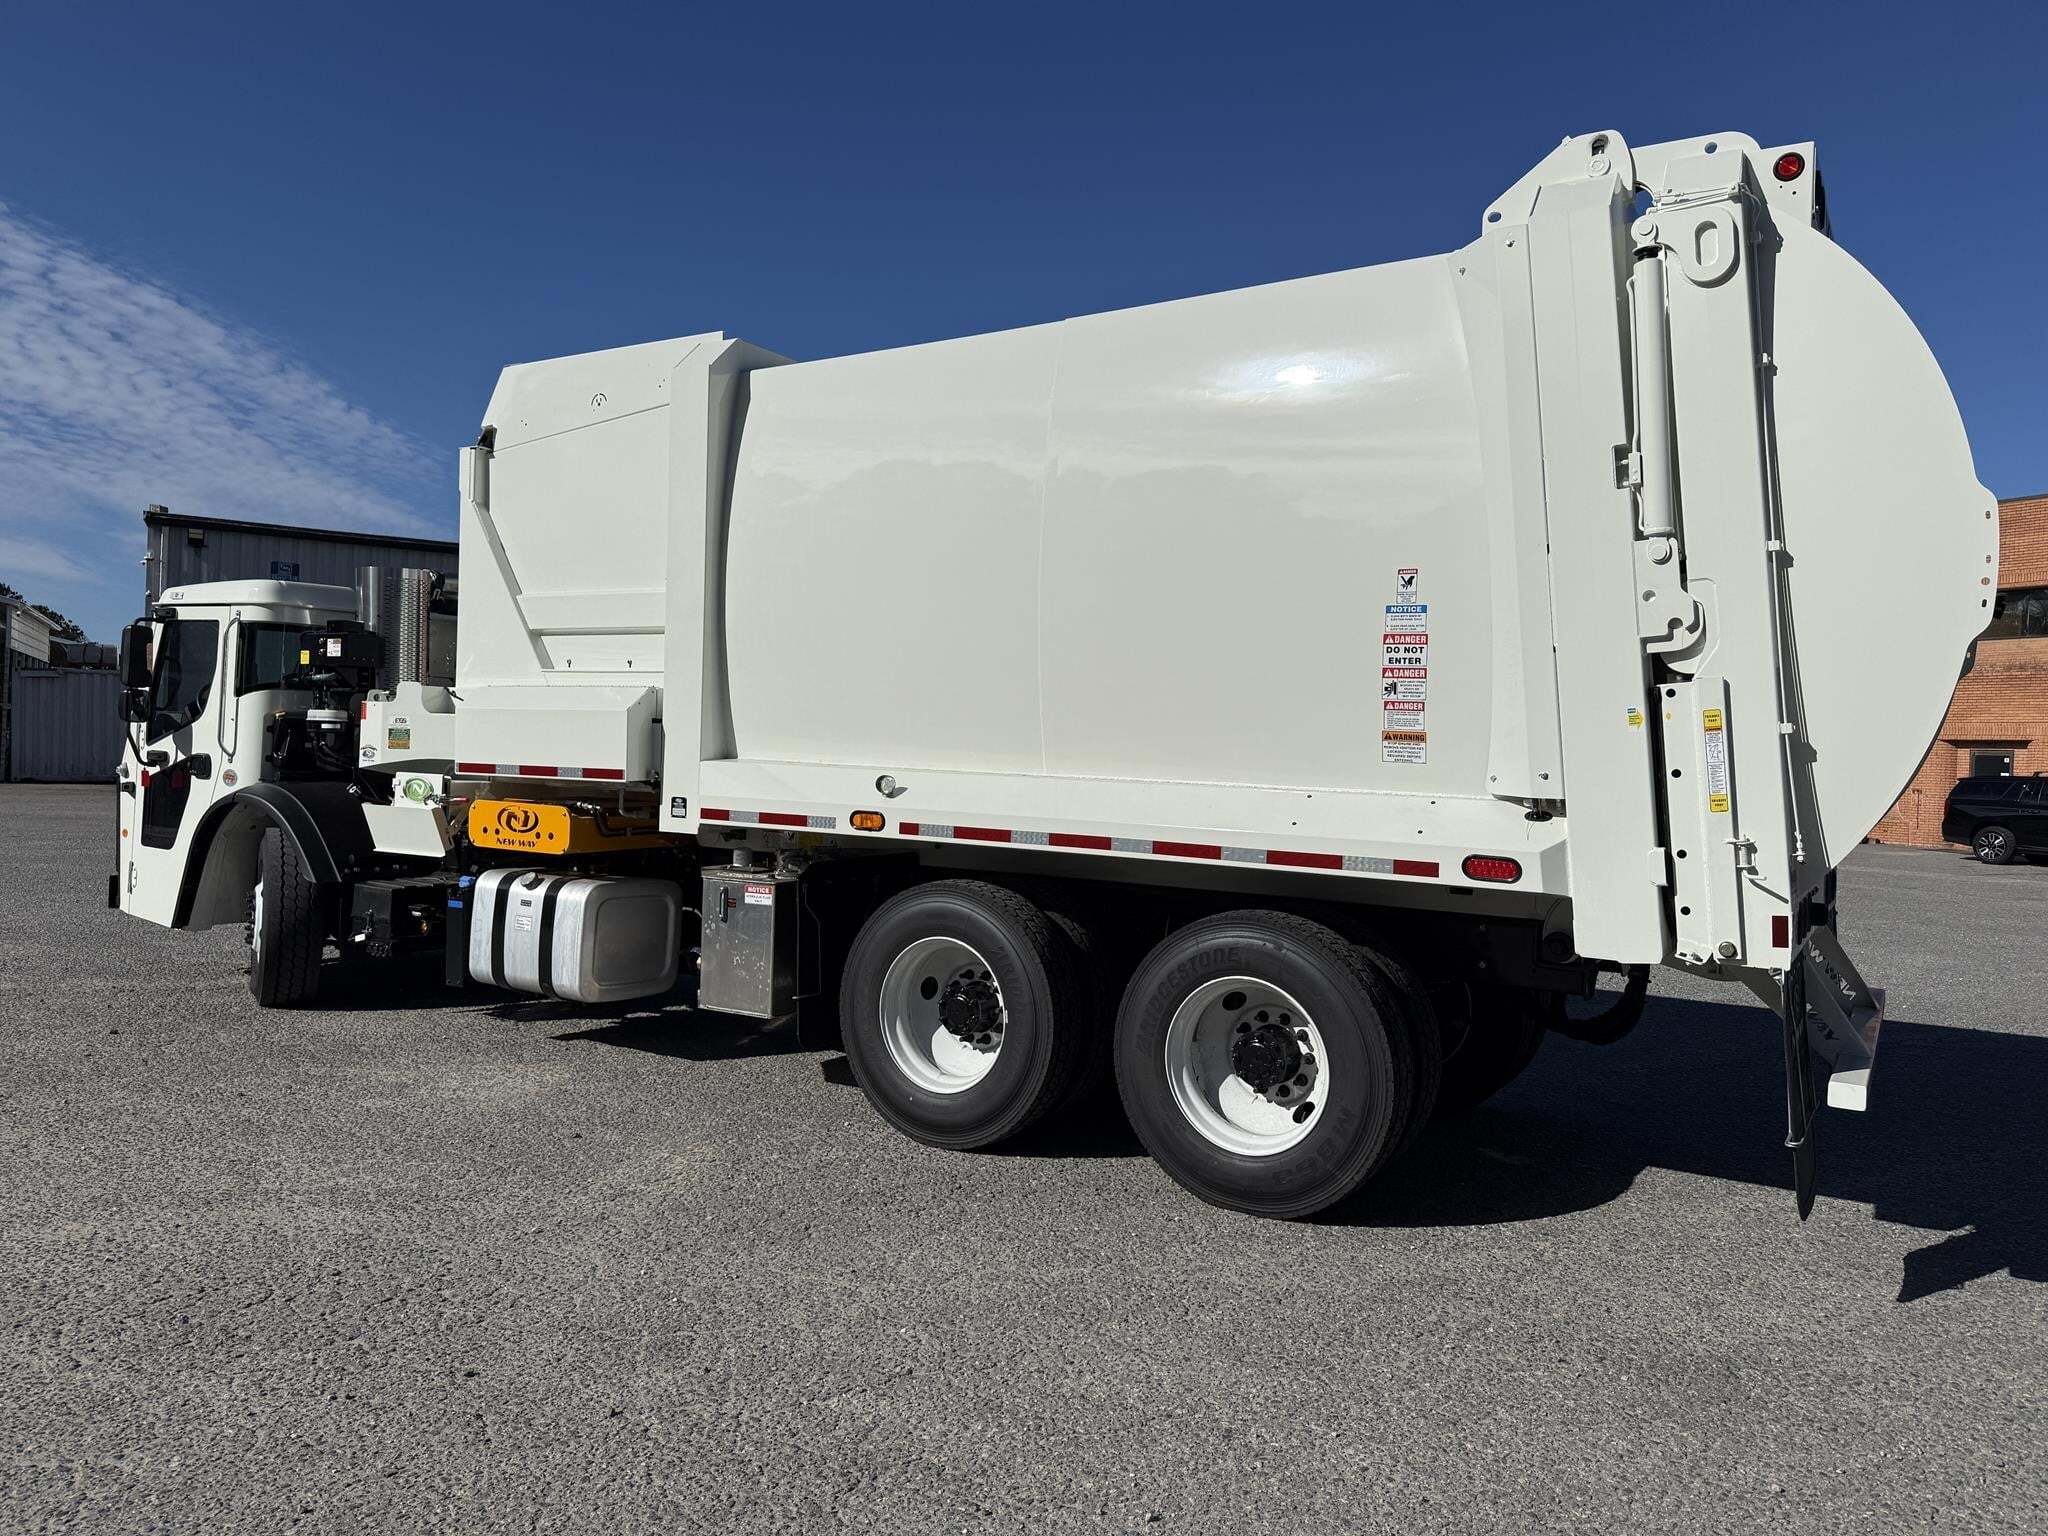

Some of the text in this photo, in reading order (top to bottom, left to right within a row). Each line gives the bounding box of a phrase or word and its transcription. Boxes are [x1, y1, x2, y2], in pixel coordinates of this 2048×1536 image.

[1394, 635, 1427, 644] DANGER
[1386, 646, 1424, 654] DO NOT
[1388, 656, 1421, 665] ENTER
[1393, 668, 1425, 678] DANGER
[1394, 702, 1423, 710] DANGER
[1392, 733, 1425, 741] WARNING
[496, 838, 537, 848] NEW WAY
[747, 886, 770, 894] NOTICE
